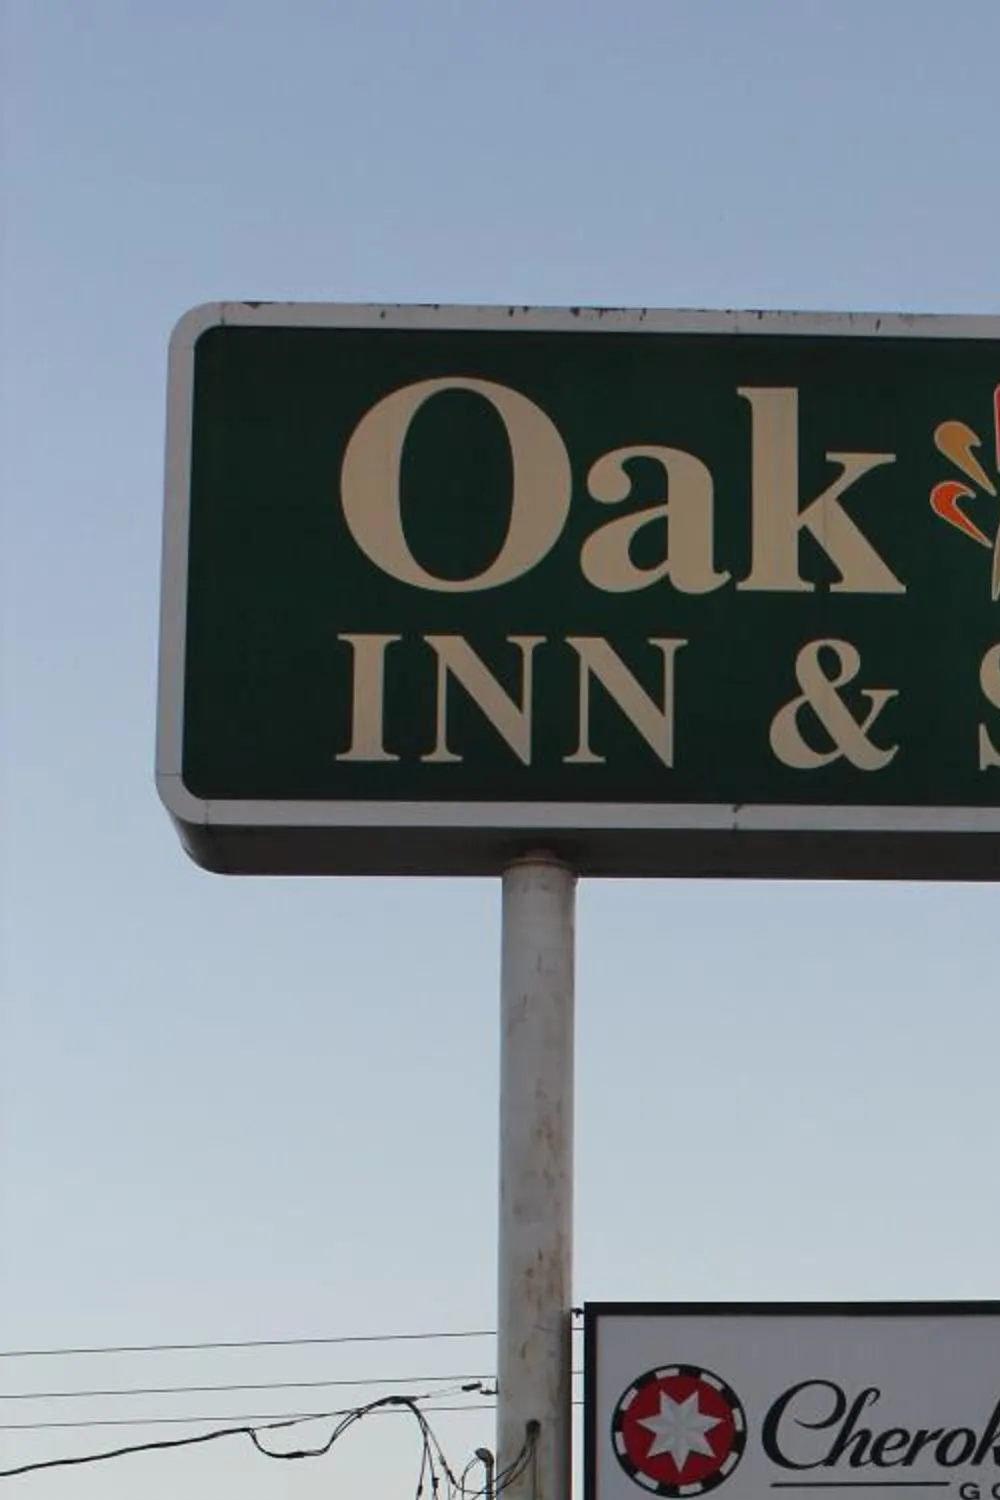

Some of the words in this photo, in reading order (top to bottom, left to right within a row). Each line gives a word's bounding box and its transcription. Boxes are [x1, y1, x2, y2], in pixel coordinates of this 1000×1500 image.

[340, 376, 908, 595] Oak
[336, 633, 689, 768] INN
[769, 638, 900, 771] &
